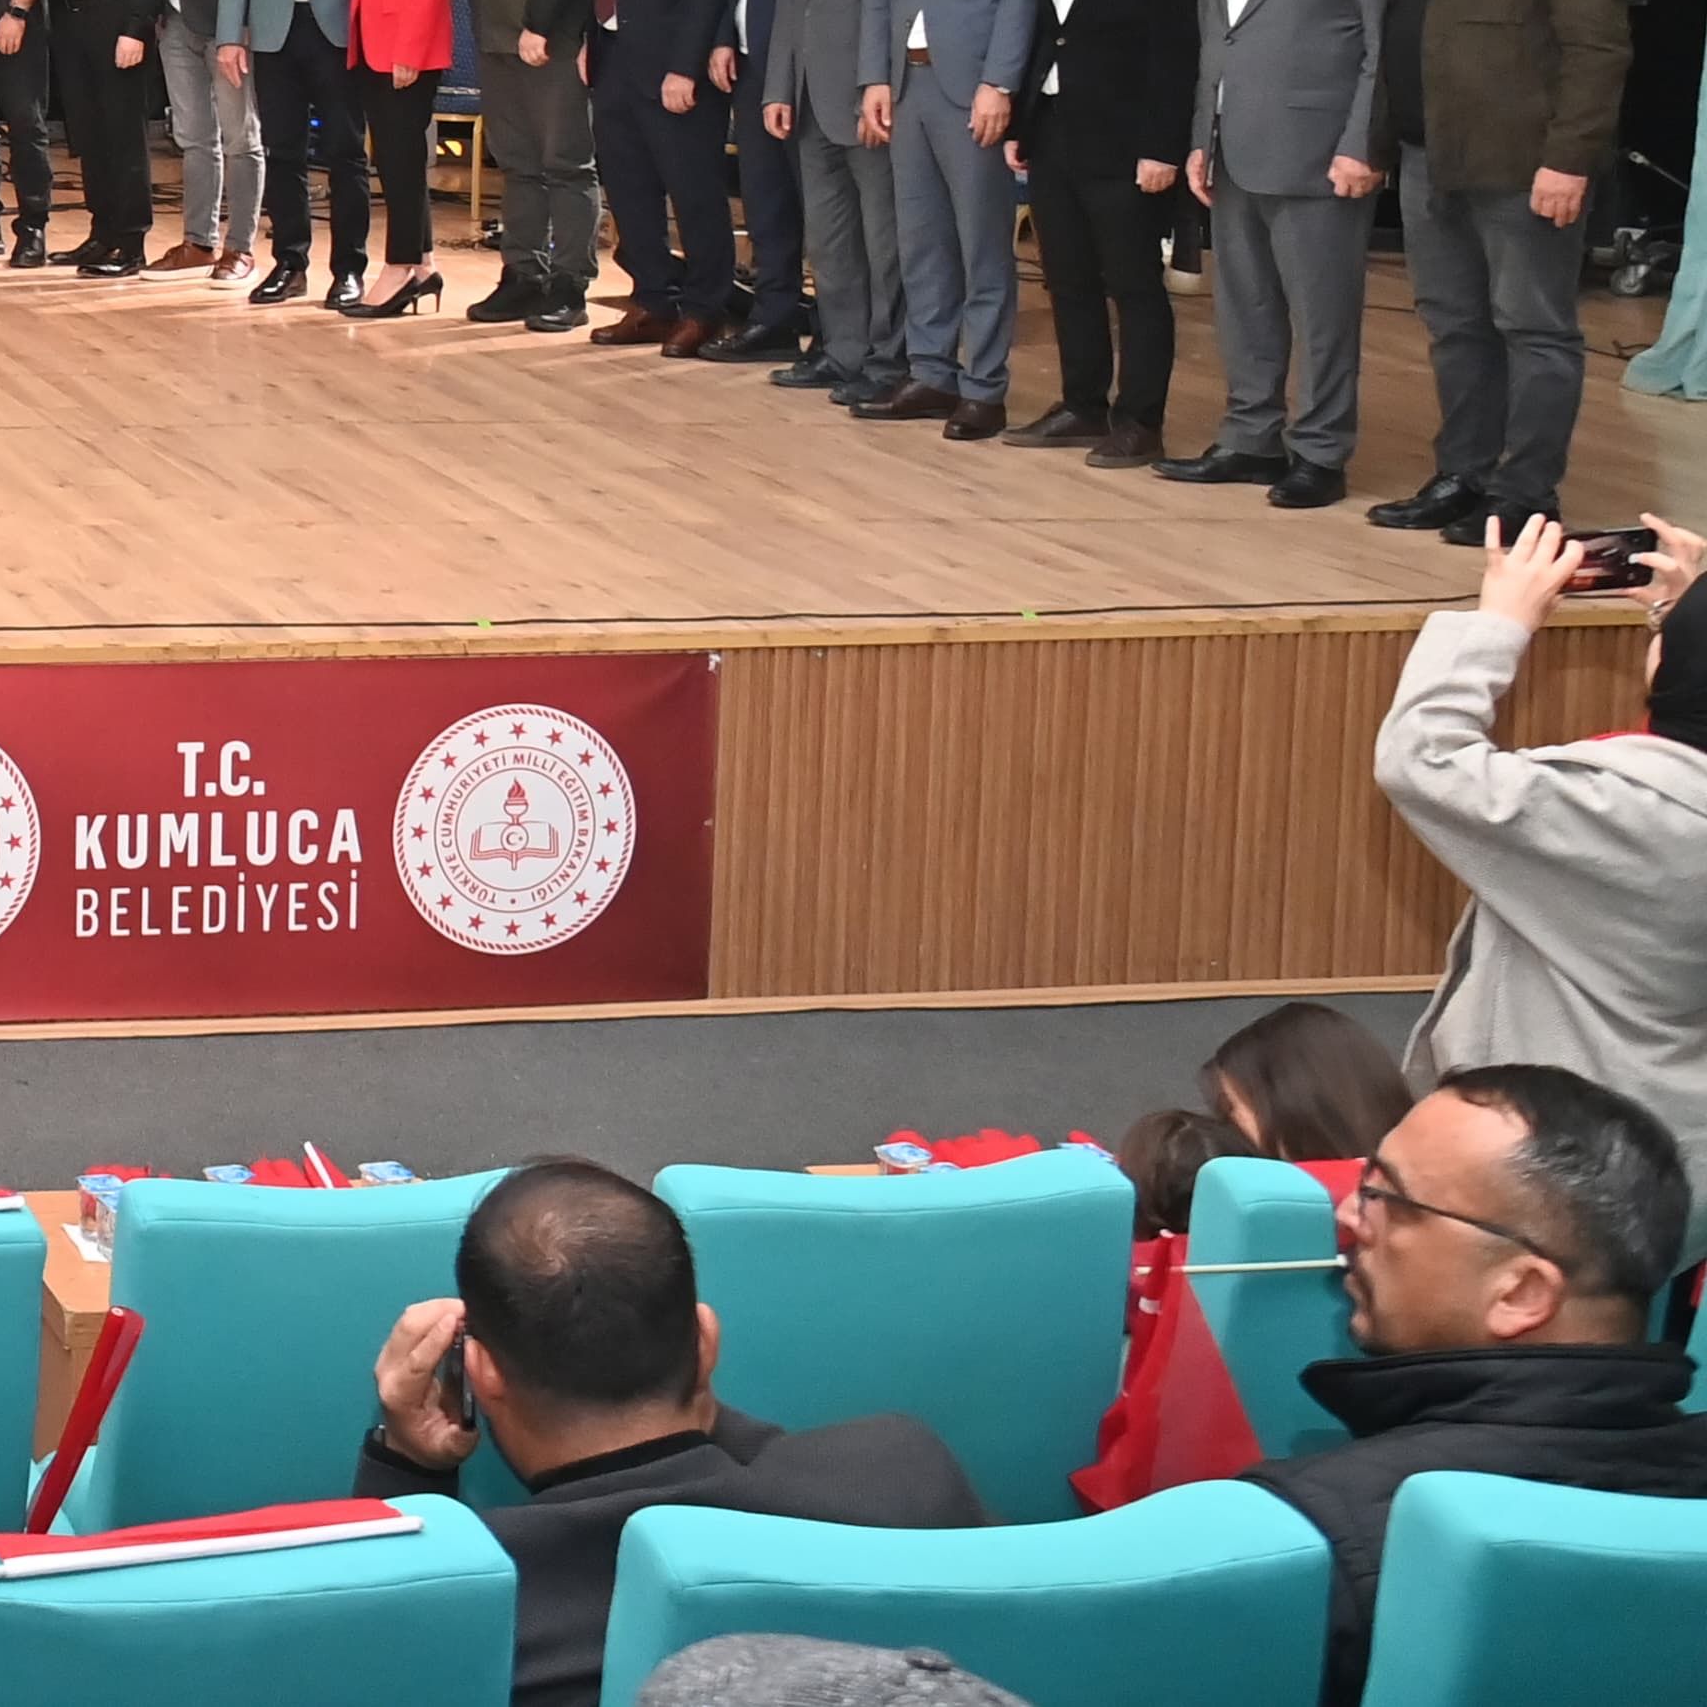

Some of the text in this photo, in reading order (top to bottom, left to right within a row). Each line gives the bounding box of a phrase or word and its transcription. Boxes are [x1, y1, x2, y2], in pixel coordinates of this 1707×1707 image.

[177, 740, 266, 798] T.C.
[74, 808, 363, 871] KUMLUCA
[74, 869, 360, 938] BELEDİYESİ
